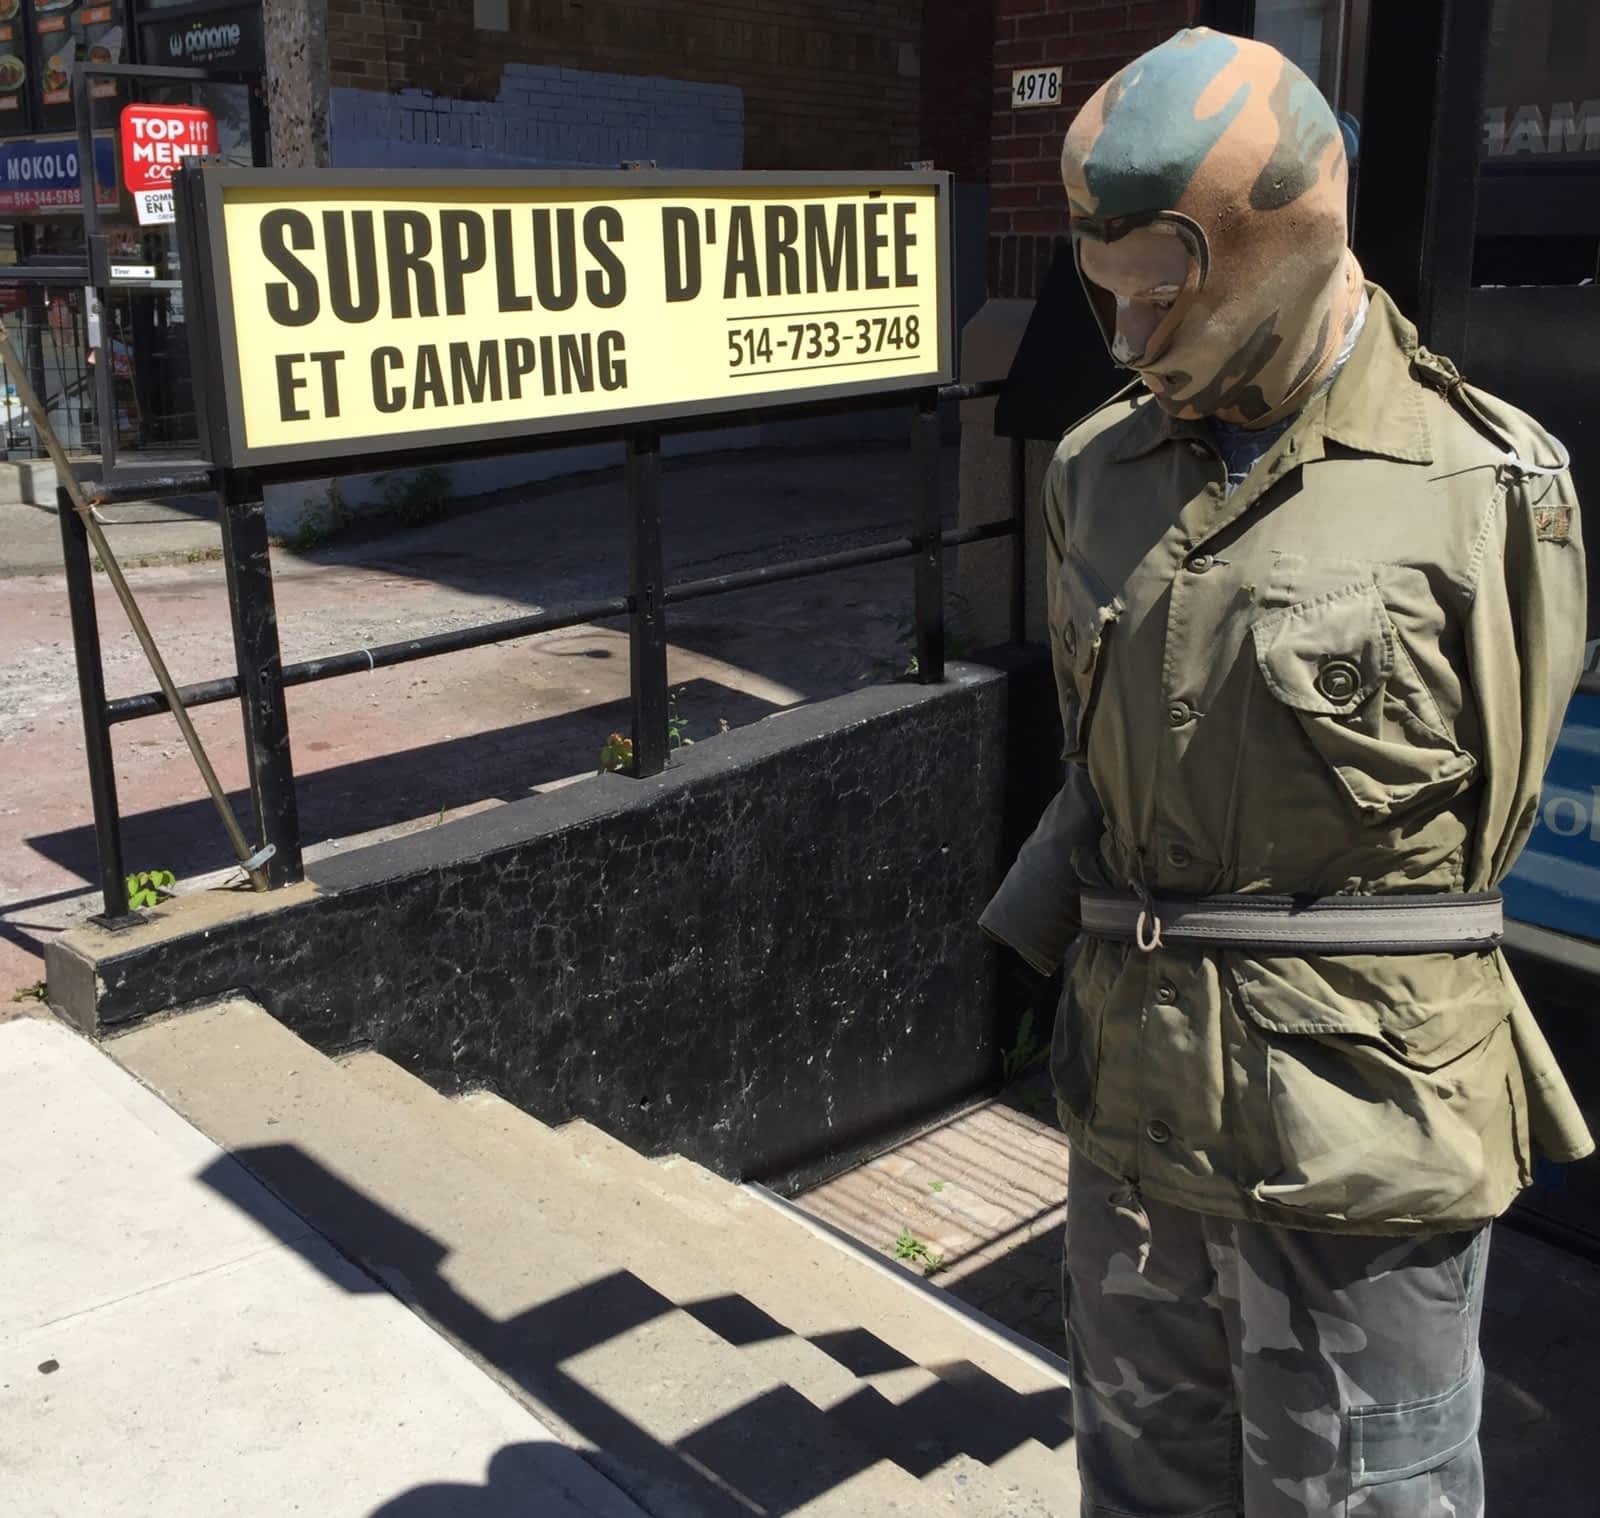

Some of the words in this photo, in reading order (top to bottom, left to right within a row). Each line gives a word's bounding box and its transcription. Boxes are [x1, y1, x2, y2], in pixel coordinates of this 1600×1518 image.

[1017, 72, 1057, 101] 4978
[130, 117, 185, 140] TOP
[7, 153, 78, 180] MOKOLO
[145, 202, 164, 214] EN
[260, 206, 627, 326] SURPLUS
[662, 189, 919, 303] D'ARMÉE
[728, 315, 920, 367] 514-733-3748
[276, 350, 345, 421] ET
[371, 331, 628, 413] CAMPING
